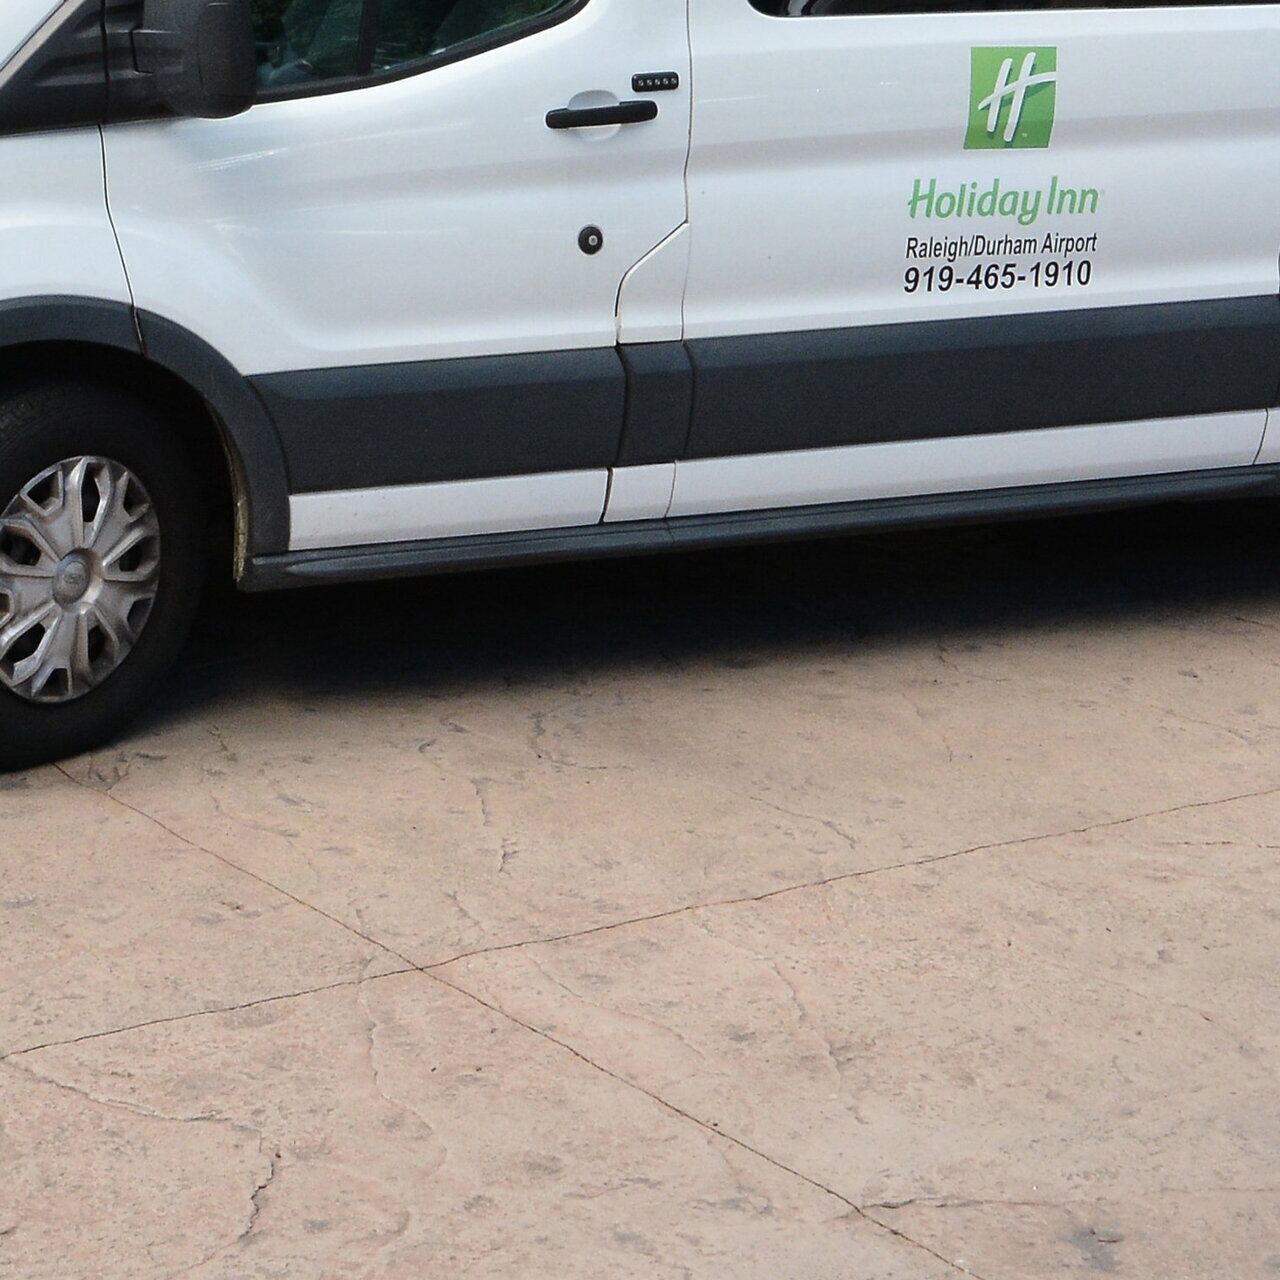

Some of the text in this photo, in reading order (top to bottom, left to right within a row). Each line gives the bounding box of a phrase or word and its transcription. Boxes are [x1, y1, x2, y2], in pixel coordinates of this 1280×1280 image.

[908, 176, 1099, 225] Holiday Inn
[906, 232, 1097, 262] Raleigh/Durham Airport
[903, 260, 1091, 293] 919-465-1910
